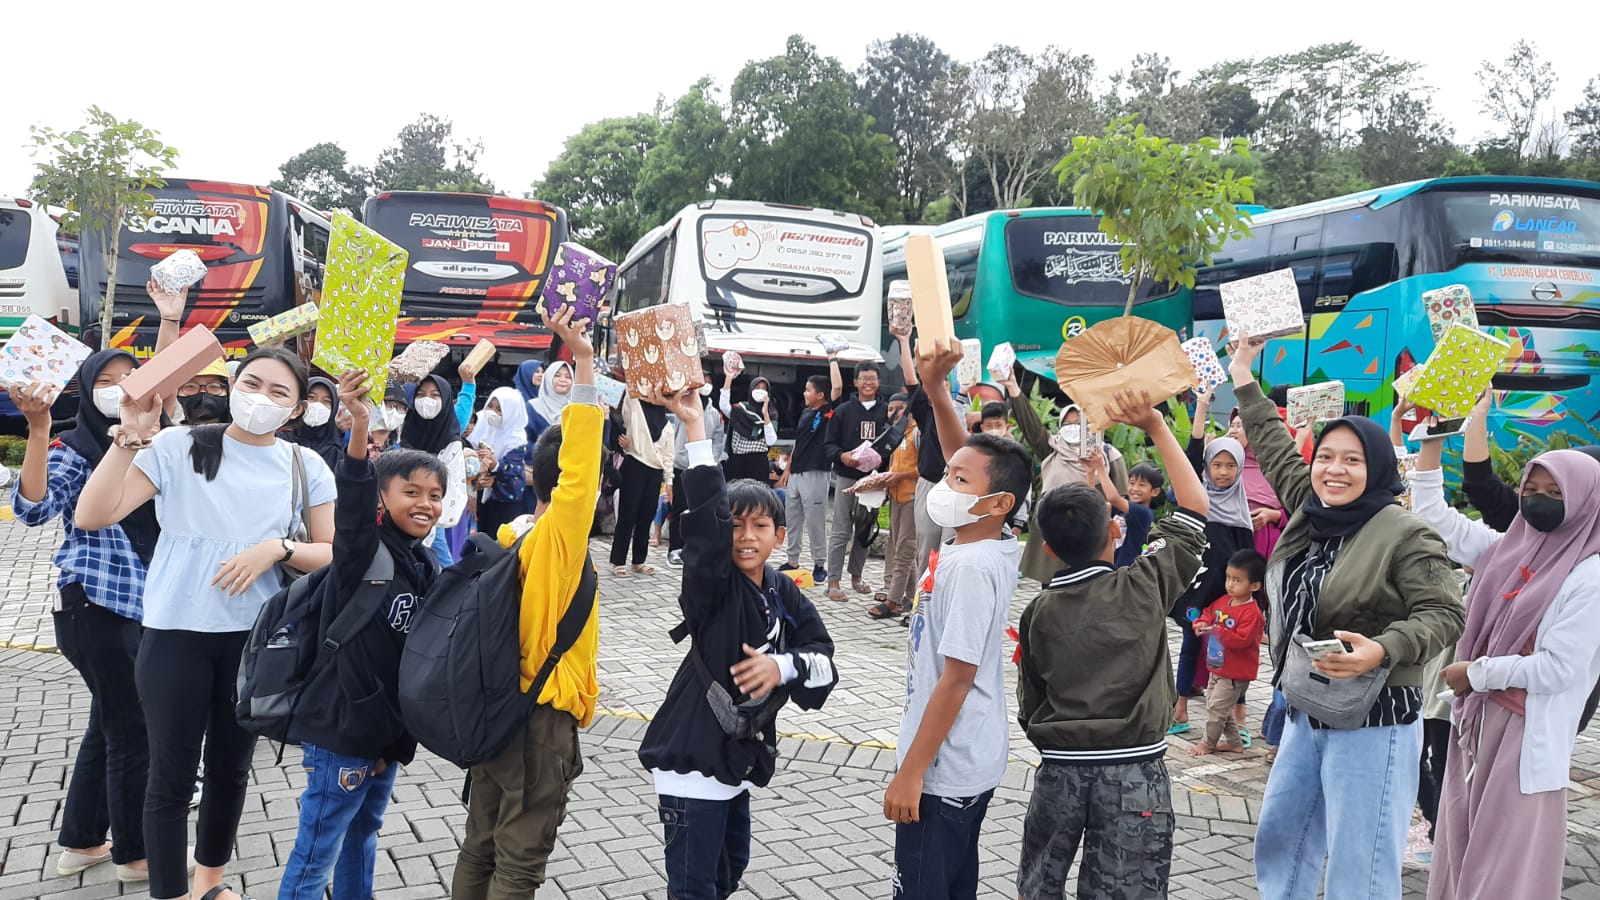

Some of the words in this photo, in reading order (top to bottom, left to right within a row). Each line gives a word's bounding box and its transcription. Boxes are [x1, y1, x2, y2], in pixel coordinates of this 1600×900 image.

[1489, 193, 1580, 210] PARIWISATA
[128, 202, 237, 218] RIWISATA
[128, 215, 236, 236] SCANIA
[409, 213, 524, 232] PARIWISATA
[467, 241, 506, 251] PUTIH
[1534, 268, 1559, 279] LANCAR
